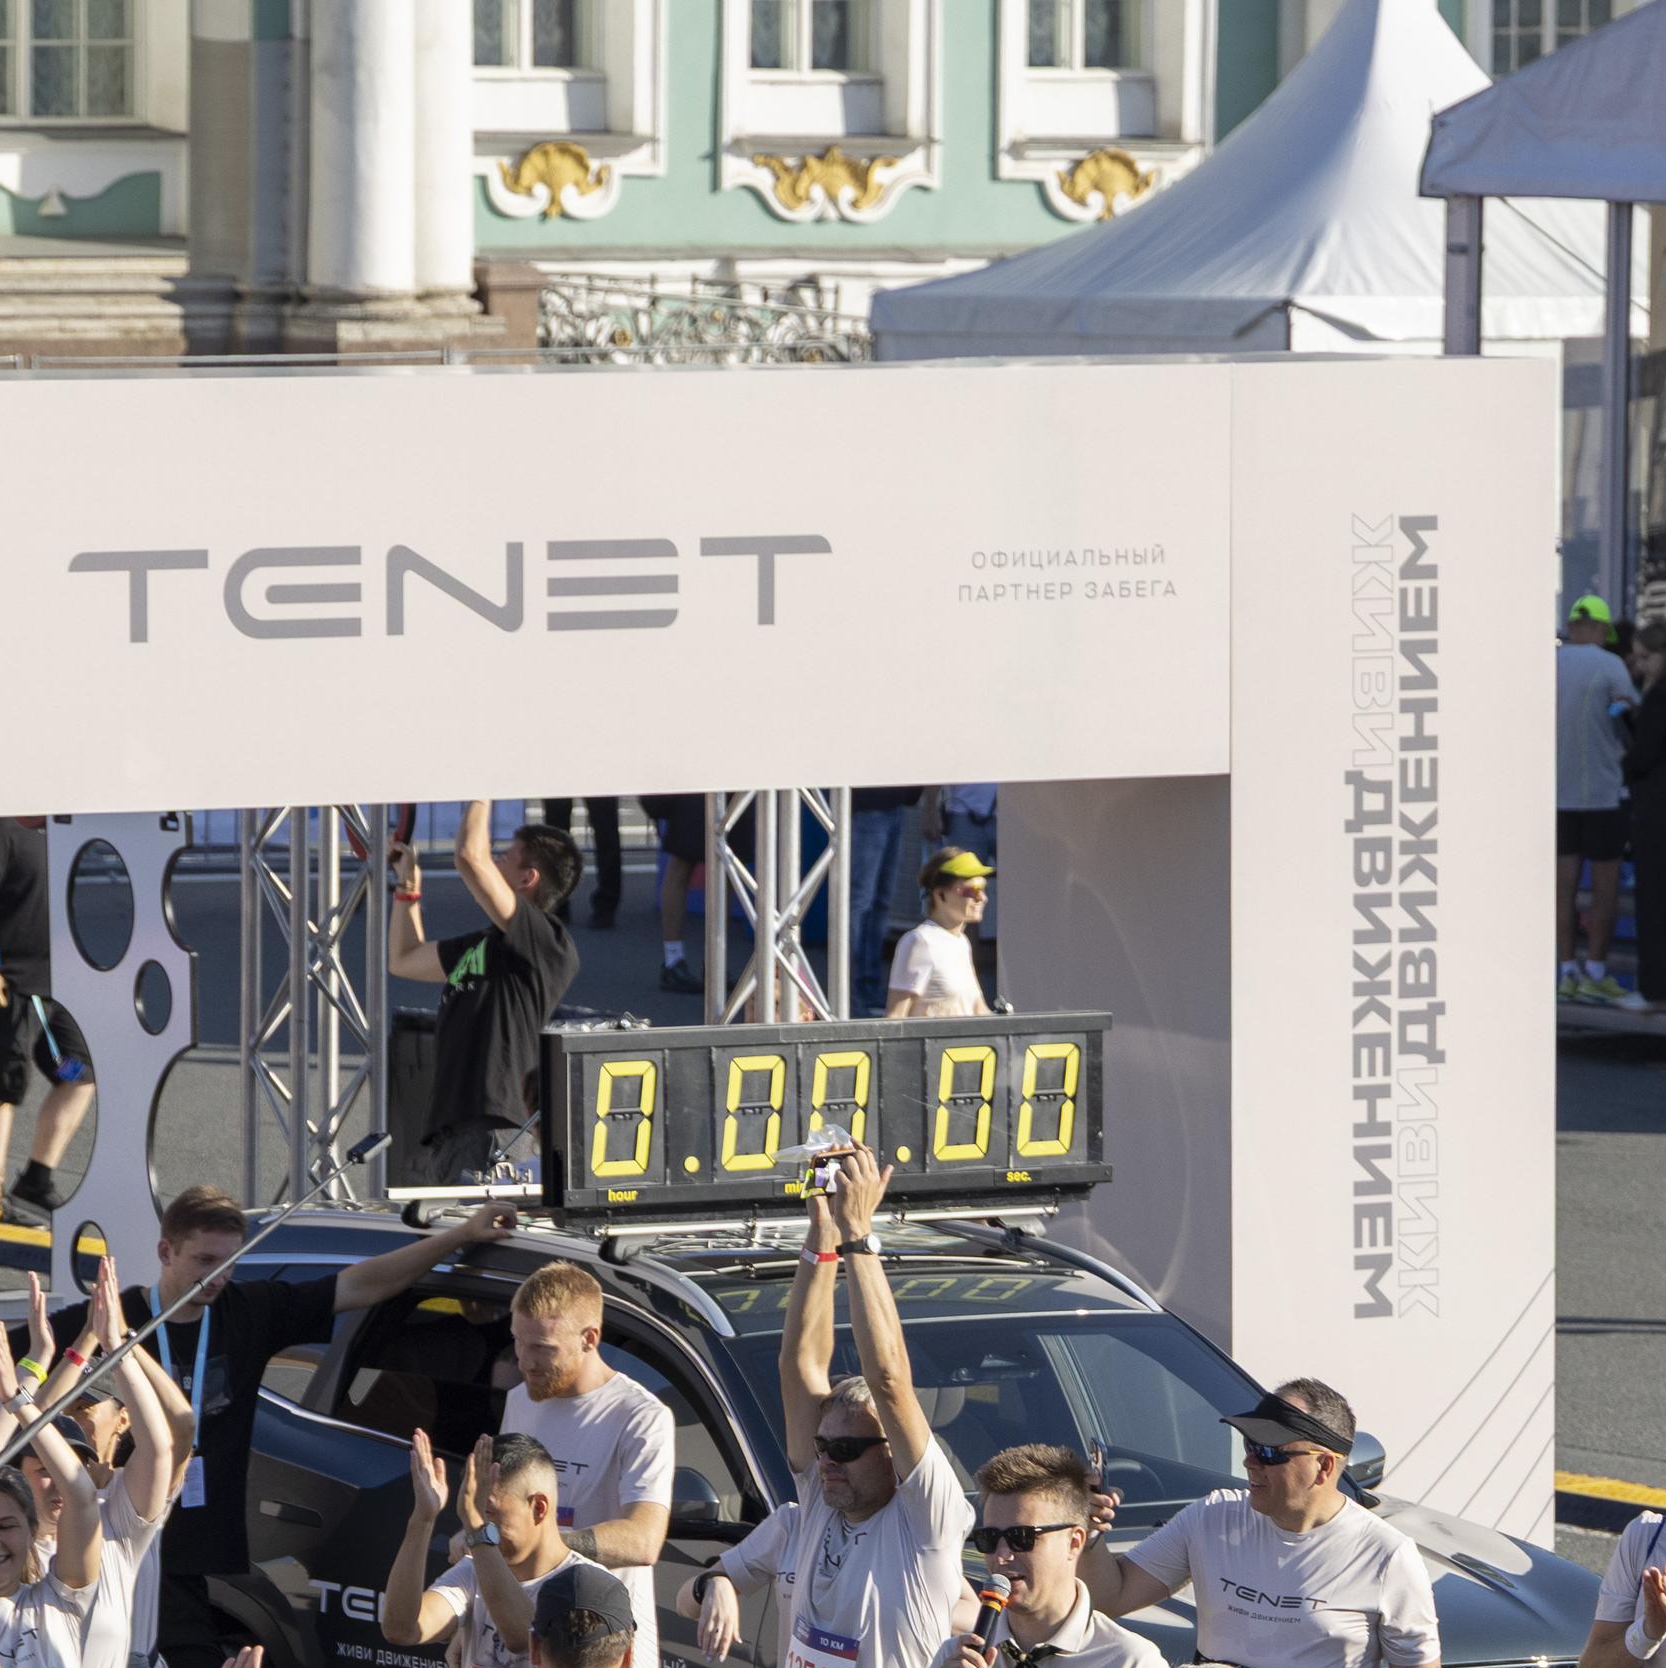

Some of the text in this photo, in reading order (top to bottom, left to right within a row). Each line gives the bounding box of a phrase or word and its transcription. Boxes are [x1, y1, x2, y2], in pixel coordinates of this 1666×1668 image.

[971, 542, 1166, 571] ОФИЦИАЛЬНЫЙ
[68, 533, 833, 644] TENET
[958, 577, 1178, 604] ПАРТНЕР ЗАБЕГА
[1344, 512, 1395, 1320] ЖИВИ ДВИЖЕНИЕМ
[1396, 514, 1447, 1320] ЖИВИ ДВИЖЕНИЕМ
[1006, 1168, 1032, 1183] sec.
[607, 1187, 638, 1203] hour
[1219, 1577, 1327, 1611] TENET
[335, 1641, 373, 1663] ЖИВИ
[819, 1637, 831, 1648] 10
